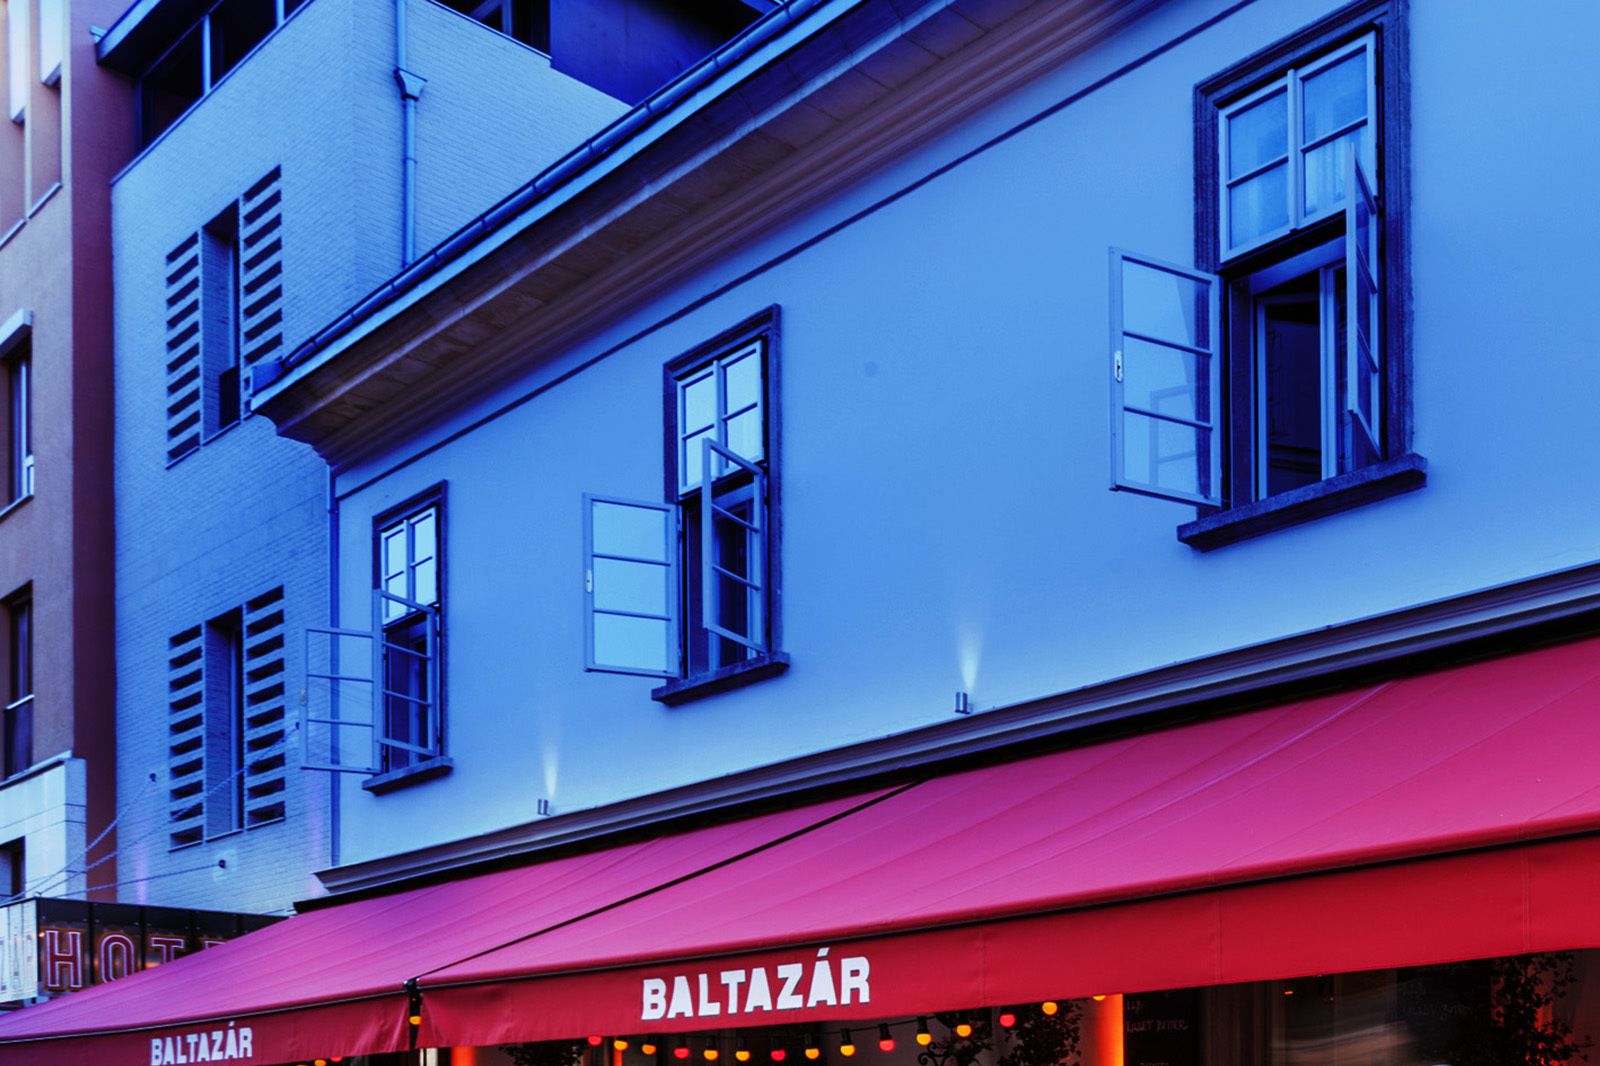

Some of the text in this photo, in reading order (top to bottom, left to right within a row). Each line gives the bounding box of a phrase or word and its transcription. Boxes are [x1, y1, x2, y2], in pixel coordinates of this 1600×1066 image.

[45, 929, 226, 989] HOT
[641, 947, 871, 1021] BALTAZÁR
[150, 1021, 253, 1066] BALTAZÁR
